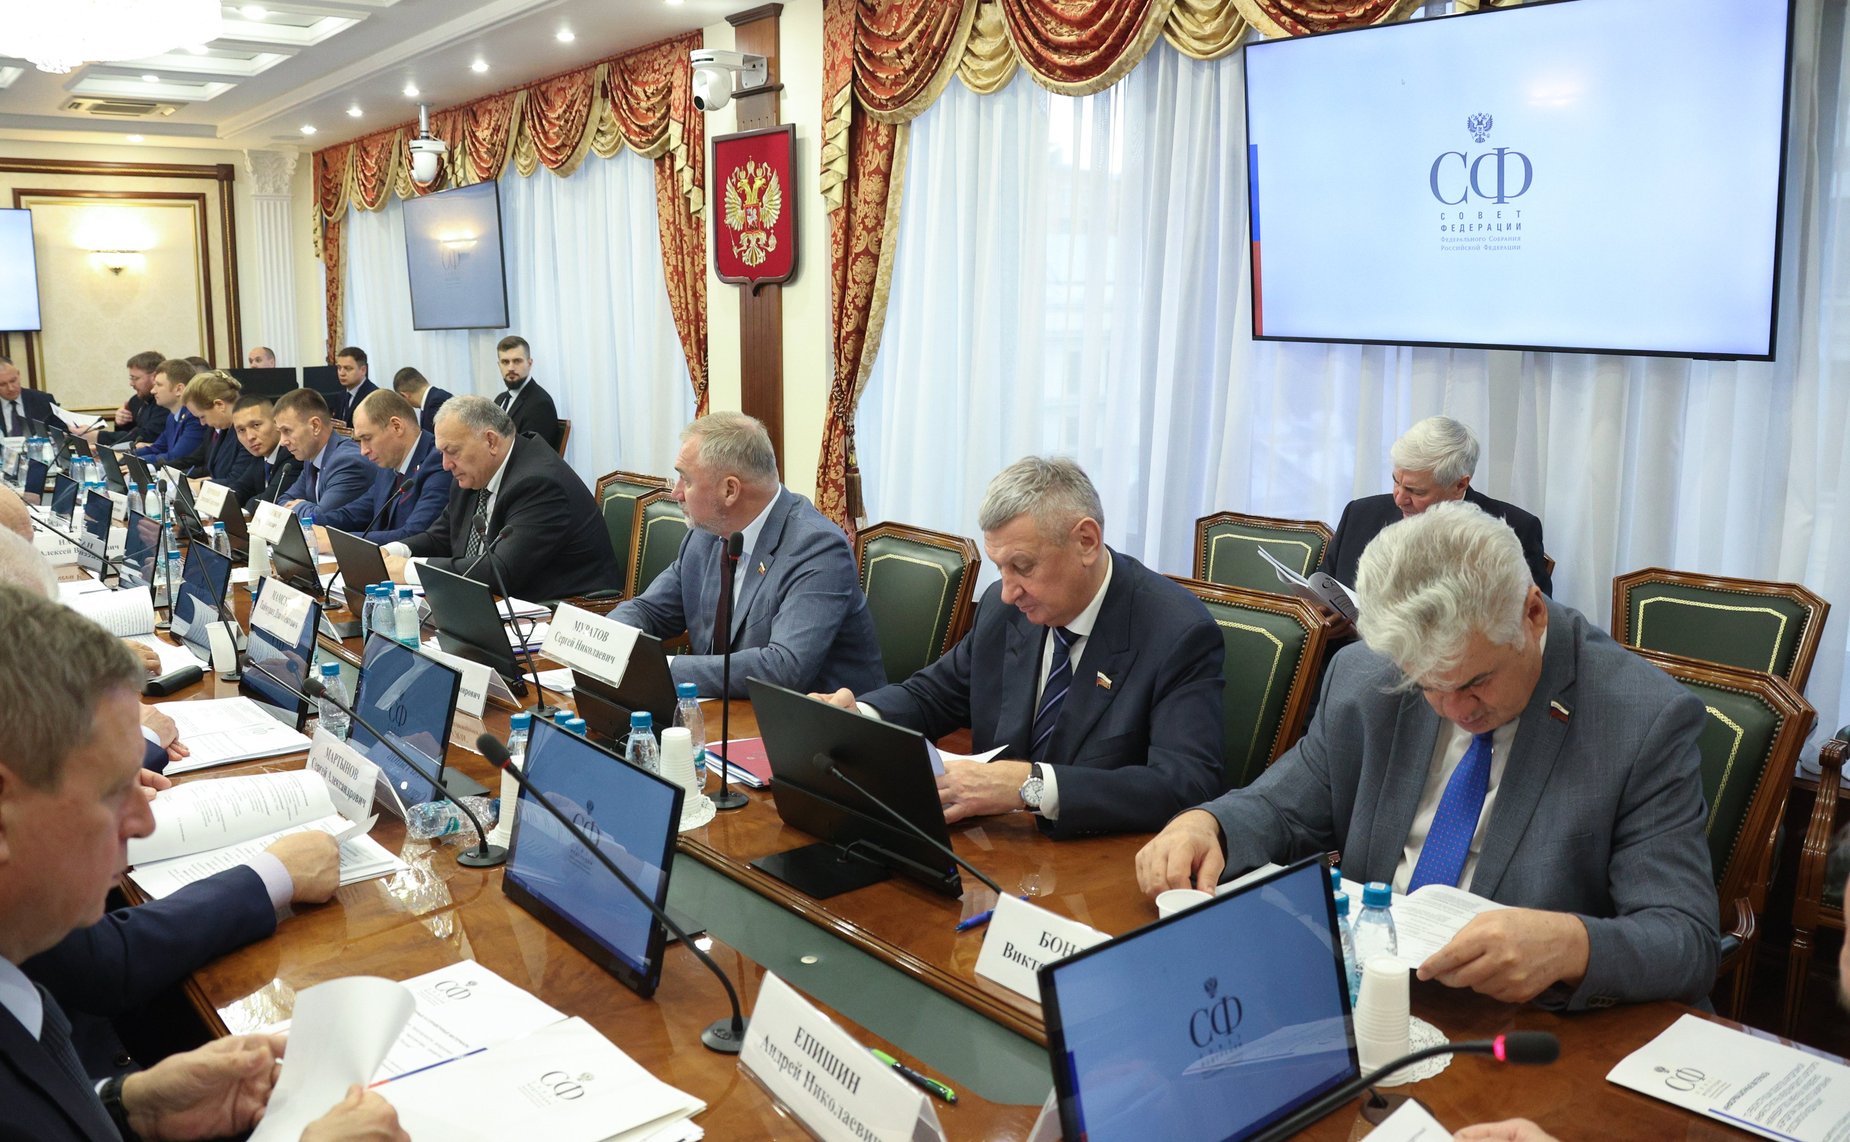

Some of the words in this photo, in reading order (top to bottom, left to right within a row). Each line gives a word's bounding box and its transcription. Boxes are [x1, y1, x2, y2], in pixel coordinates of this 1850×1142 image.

[1430, 147, 1533, 205] СФ
[1440, 210, 1521, 220] СОВЕТ
[1440, 222, 1521, 233] ФЕДЕРАЦИИ
[574, 620, 610, 643] МУРАТОВ
[554, 631, 575, 648] Сергей
[575, 639, 616, 665] Николаевич
[326, 746, 360, 780] МАРТЫНОВ
[311, 757, 328, 778] Сергей
[328, 771, 367, 808] Александрович
[1038, 930, 1082, 958] БОН
[434, 980, 472, 1000] СФ
[1189, 995, 1243, 1048] СФ
[760, 1034, 802, 1081] Андрей
[794, 1026, 861, 1095] ЕПИШИН
[541, 1070, 585, 1100] СФ
[1665, 1067, 1706, 1092] СФ
